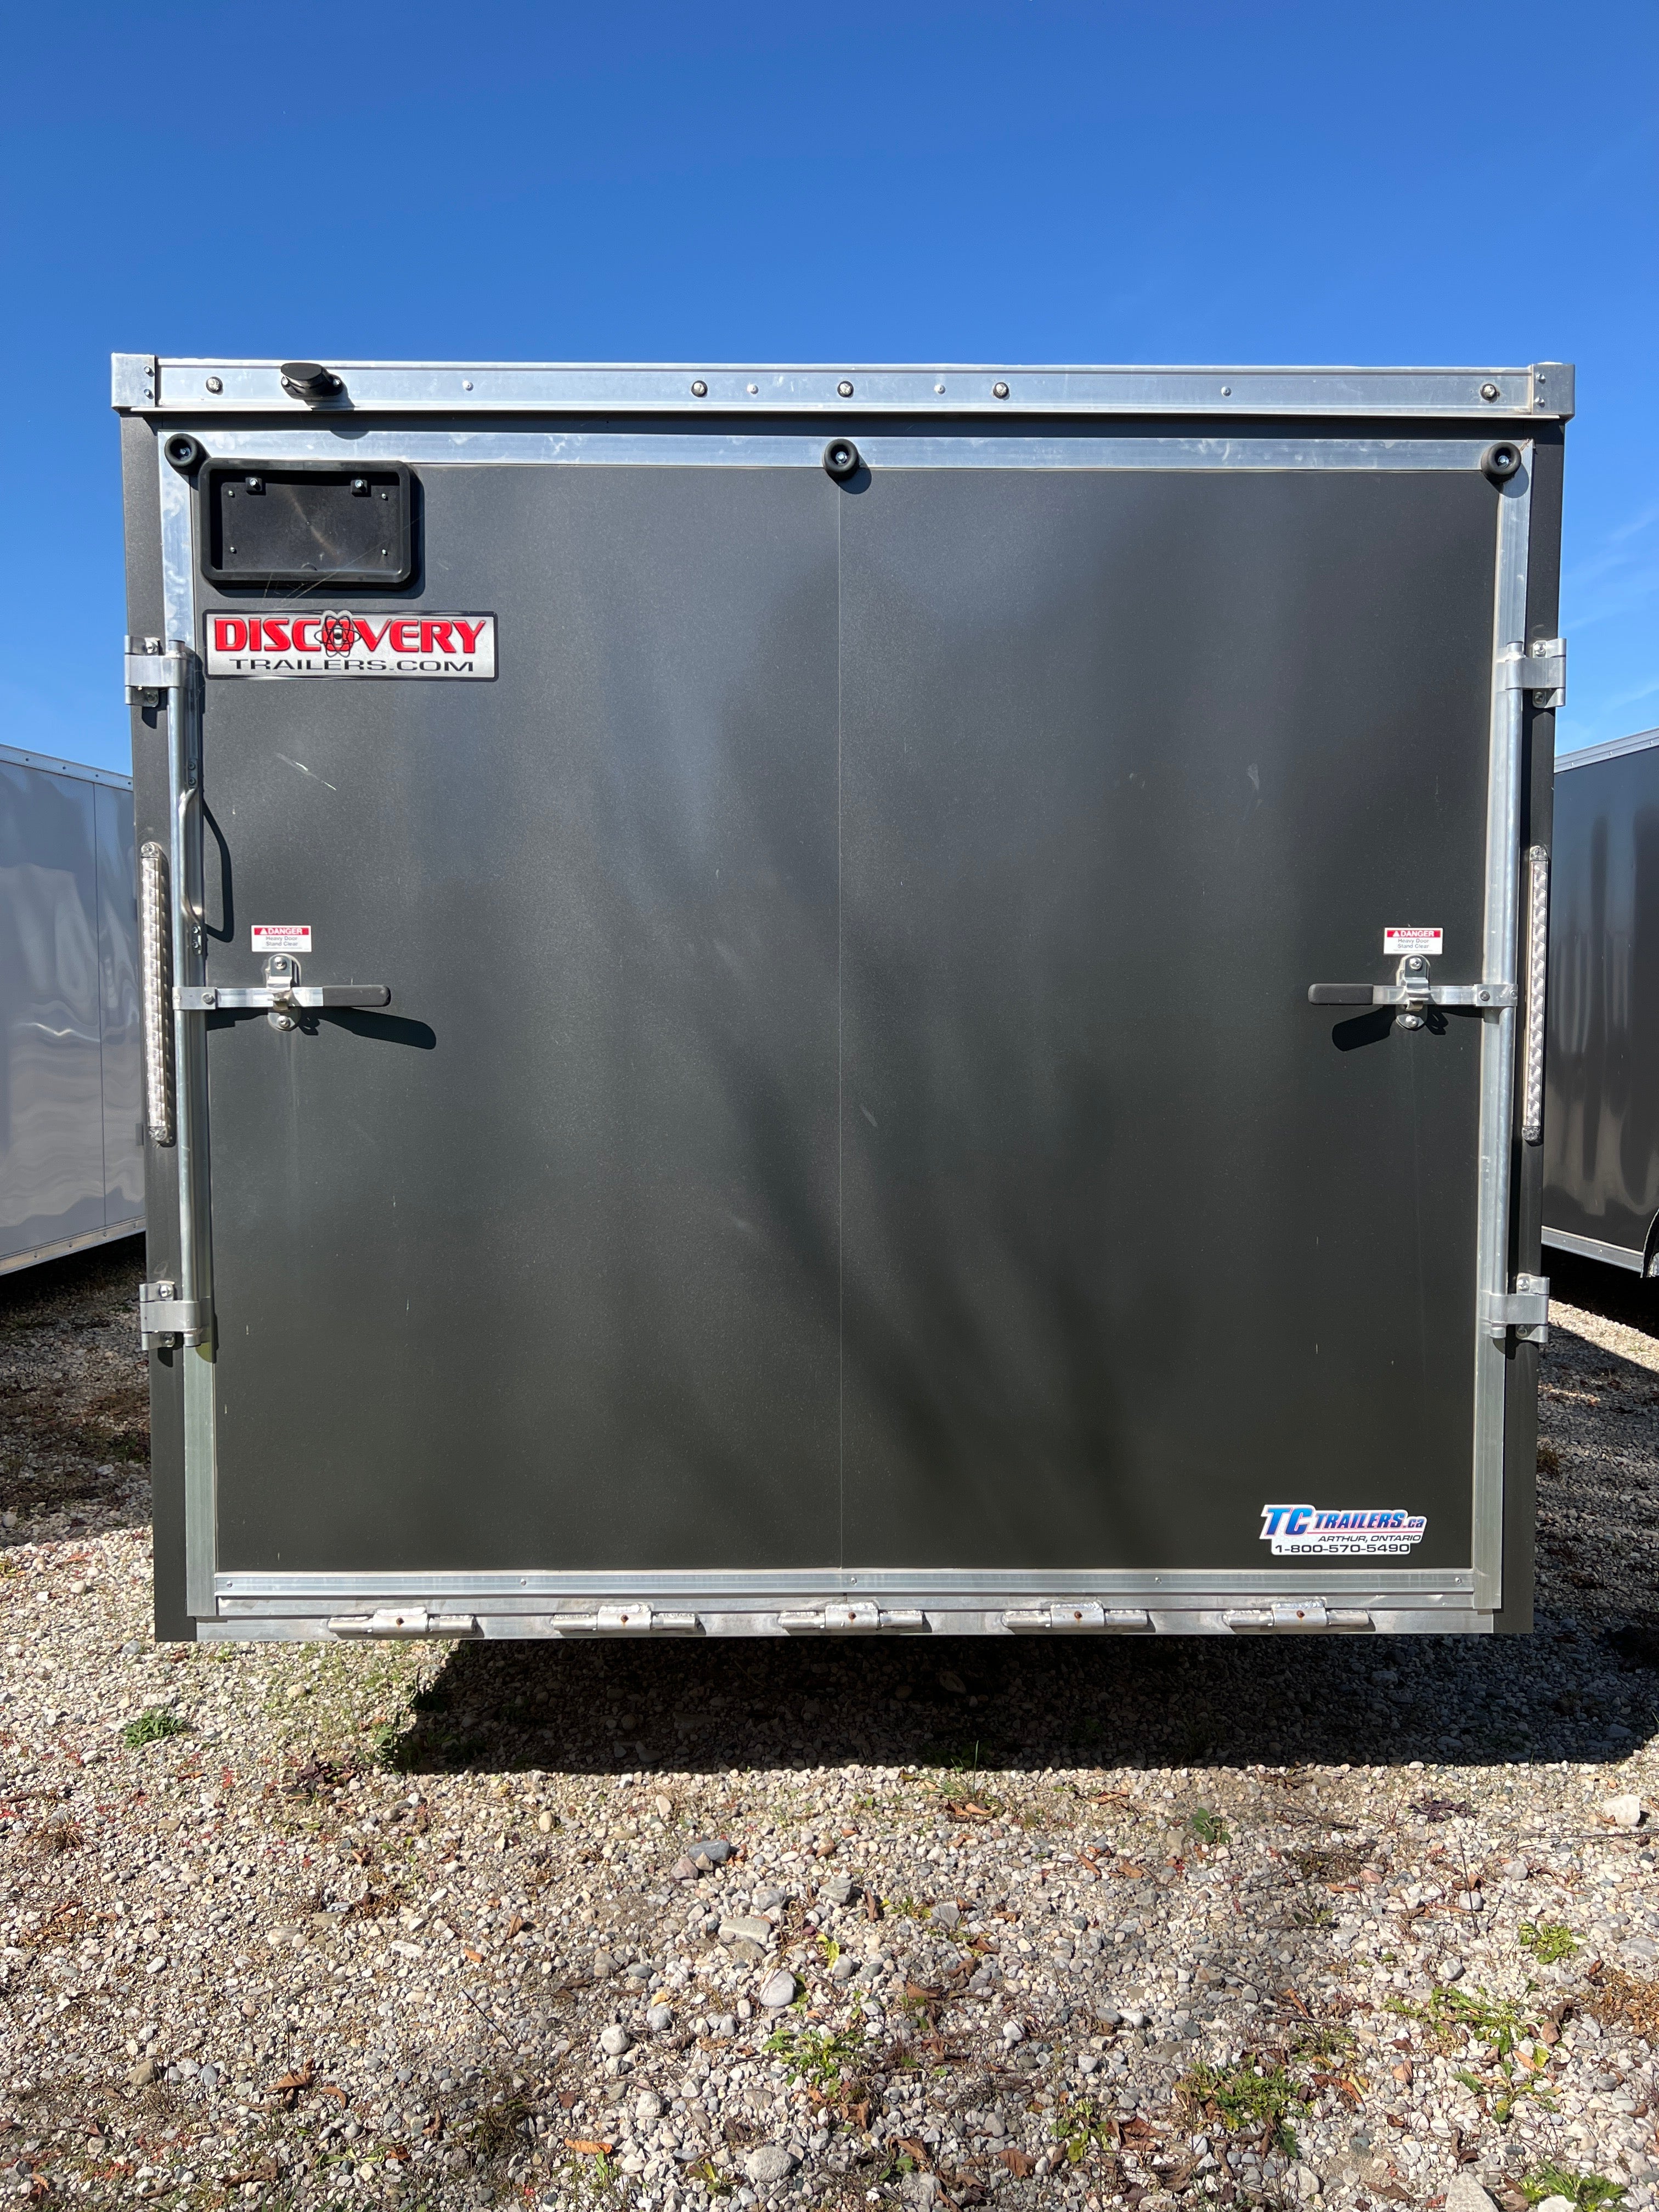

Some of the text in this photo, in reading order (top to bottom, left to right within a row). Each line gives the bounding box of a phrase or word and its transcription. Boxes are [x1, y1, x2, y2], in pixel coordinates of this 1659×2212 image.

[215, 616, 486, 655] DISCOVERY
[229, 658, 473, 672] TRAILERS.COM
[1265, 1507, 1425, 1536] TC TRAILERS.ca
[1275, 1544, 1410, 1553] 1-800-570-5490
